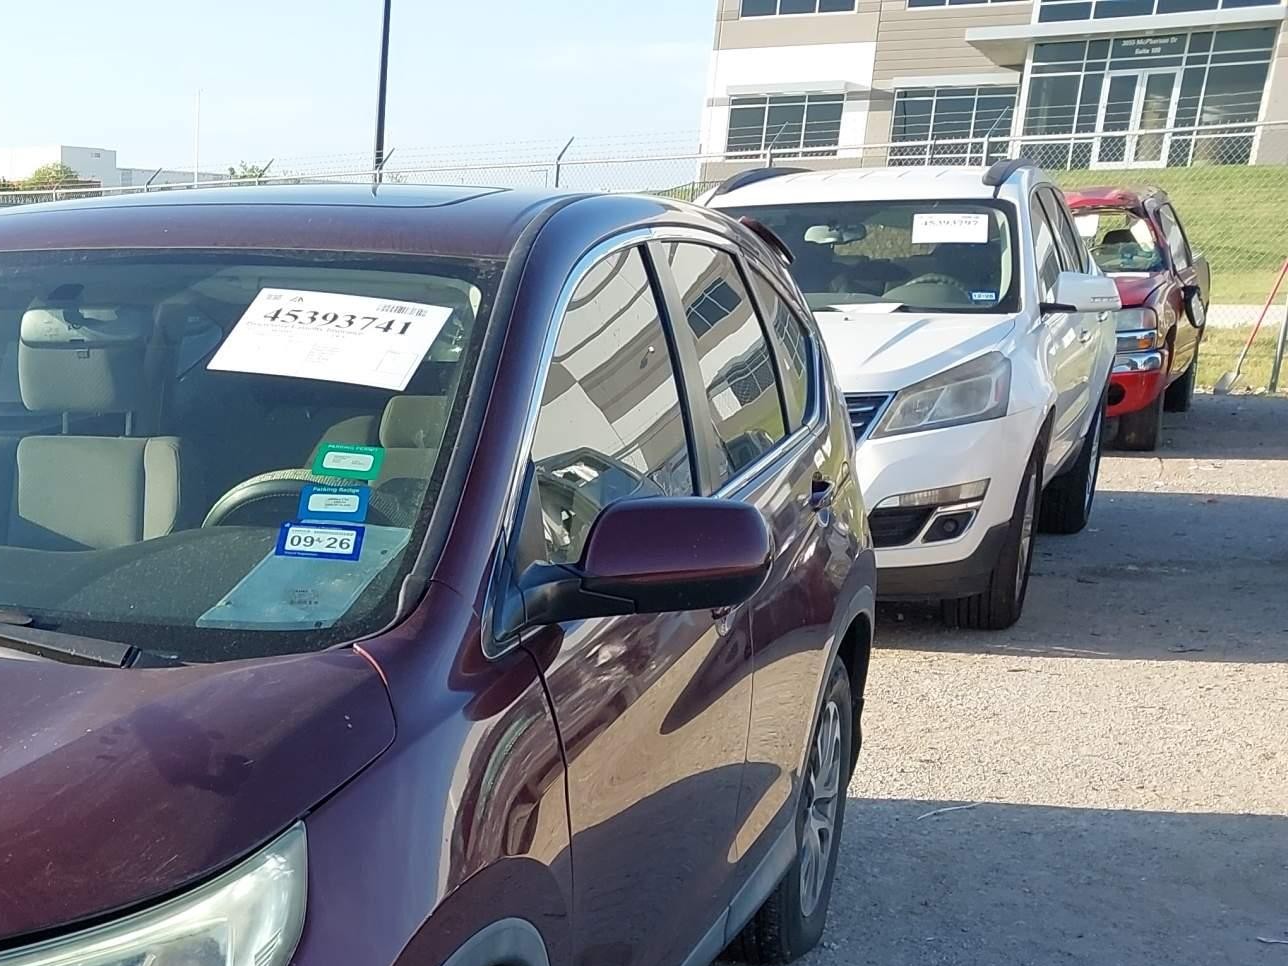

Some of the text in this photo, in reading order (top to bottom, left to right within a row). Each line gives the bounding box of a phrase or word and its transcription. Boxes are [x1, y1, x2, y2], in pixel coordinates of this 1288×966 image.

[263, 306, 413, 337] 45393741
[290, 534, 351, 549] 09 26
